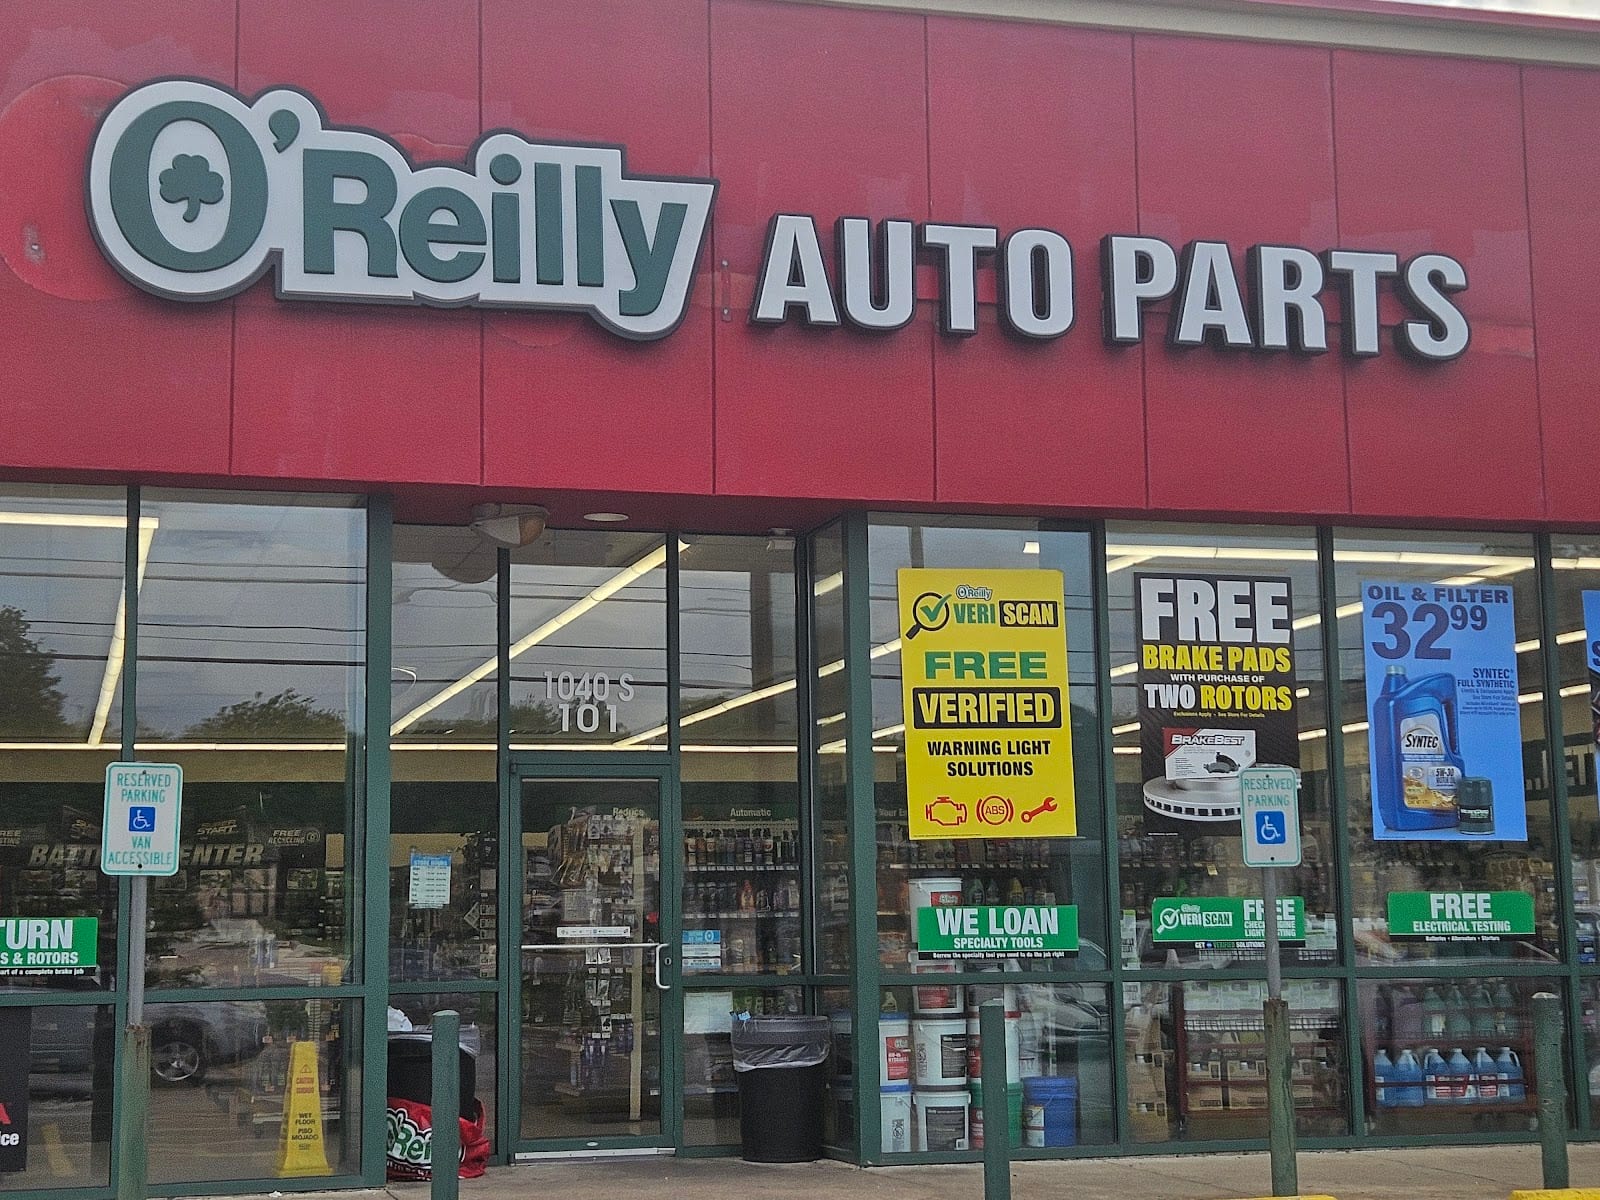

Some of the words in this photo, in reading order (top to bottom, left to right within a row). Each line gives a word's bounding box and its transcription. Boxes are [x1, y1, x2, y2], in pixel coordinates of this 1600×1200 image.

[109, 99, 688, 317] O'Reilly
[755, 215, 1074, 336] AUTO
[1110, 235, 1469, 356] PARTS
[956, 585, 993, 600] O'Reilly
[1368, 585, 1405, 601] OIL
[1412, 587, 1427, 602] &
[1434, 587, 1508, 603] FILTER
[953, 603, 996, 624] VERI
[1002, 602, 1055, 625] SCAN
[1140, 578, 1290, 643] FREE
[924, 652, 1048, 679] FREE
[1142, 645, 1224, 671] BRAKE
[1227, 646, 1292, 673] PADS
[544, 670, 610, 701] 1040
[618, 672, 635, 701] S
[1170, 673, 1196, 682] WITH
[1197, 674, 1250, 683] PURCHASE
[1251, 675, 1265, 683] OF
[1457, 679, 1475, 688] FULL
[1476, 680, 1514, 689] SYNTHETIC
[1144, 683, 1196, 709] TWO
[1200, 685, 1293, 711] ROTORS
[917, 692, 1055, 723] VERIFIED
[559, 703, 617, 733] 101
[927, 741, 1001, 756] WARNING
[1008, 740, 1050, 755] LIGHT
[1405, 734, 1439, 748] SYNTEC
[947, 761, 1034, 776] SOLUTIONS
[116, 773, 171, 787] RESERVED
[1244, 778, 1293, 790] RESERVED
[121, 789, 166, 803] PARKING
[1247, 795, 1290, 807] PARKING
[730, 807, 771, 817] Automatic
[985, 805, 1005, 815] ABS
[131, 836, 152, 849] VAN
[29, 844, 102, 866] BATT
[181, 843, 264, 866] ENTER
[107, 851, 173, 864] ACCESSIBLE
[1430, 893, 1492, 919] FREE
[936, 908, 979, 935] WE
[989, 908, 1058, 935] LOAN
[1180, 913, 1202, 925] VERI
[1205, 913, 1230, 925] SCAN
[1413, 921, 1470, 932] ELECTRICAL
[1472, 921, 1511, 932] TESTING
[0, 920, 73, 949] URN
[953, 937, 1008, 949] SPECIALTY
[1011, 937, 1043, 949] TOOLS
[13, 952, 23, 965] &
[27, 952, 79, 964] ROTORS
